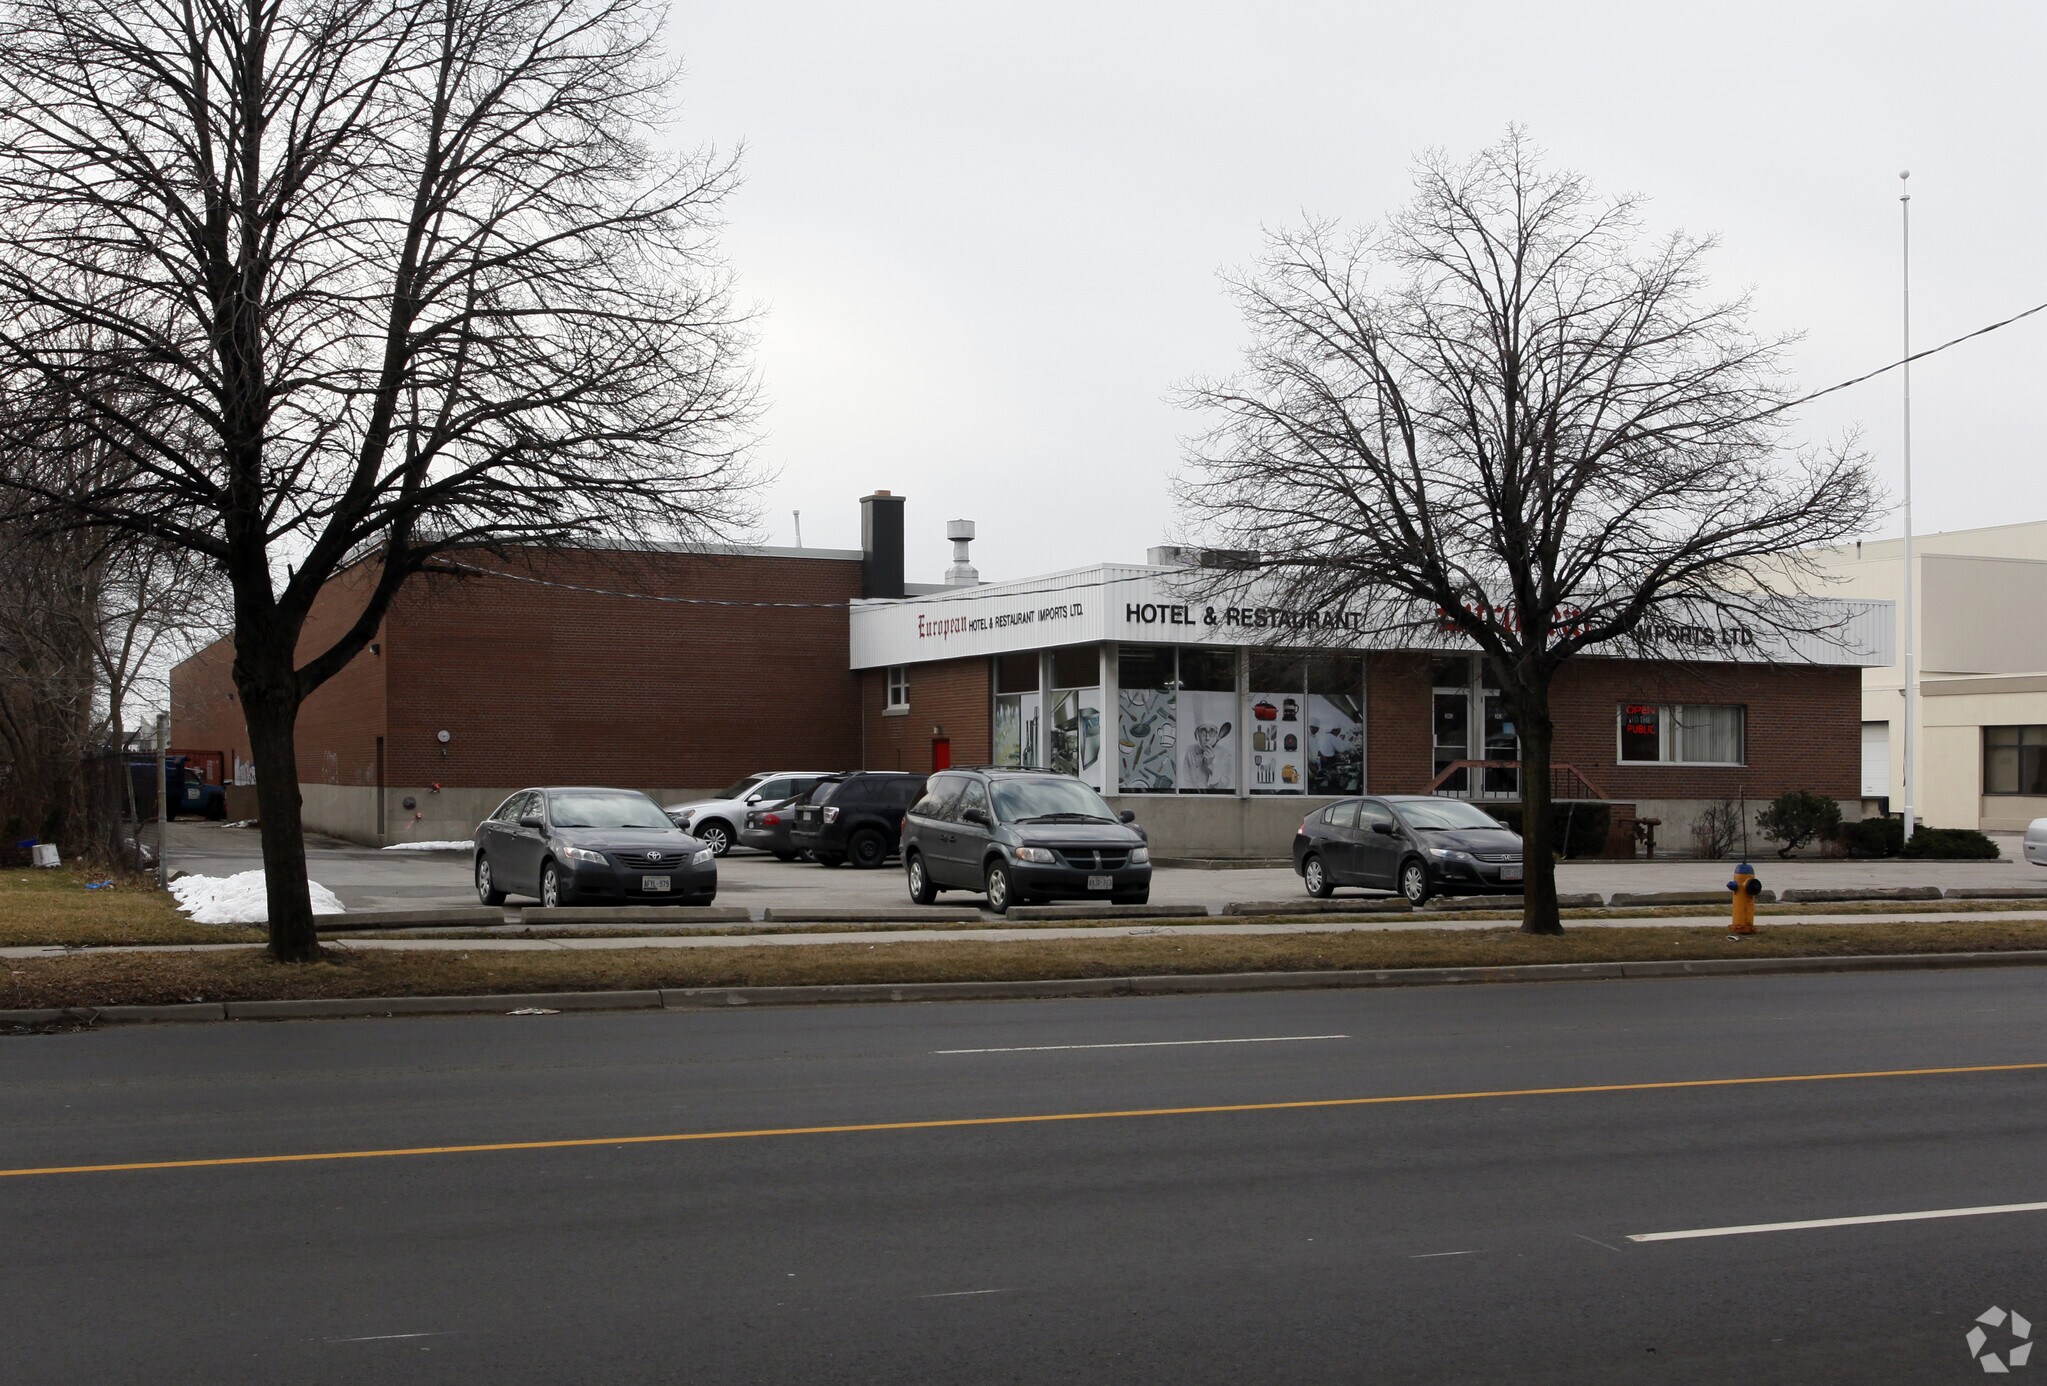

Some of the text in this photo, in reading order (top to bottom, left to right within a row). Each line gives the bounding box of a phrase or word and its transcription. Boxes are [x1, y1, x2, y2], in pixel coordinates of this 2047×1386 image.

[918, 614, 967, 640] European
[969, 617, 988, 632] HOTEL
[995, 610, 1035, 628] RESTAURANT
[1038, 605, 1068, 622] IMPORTS
[1126, 603, 1363, 630] HOTEL & RESTAURANT
[1632, 624, 1715, 646] MPORTS
[1626, 705, 1656, 714] OPEN
[1627, 724, 1655, 734] PUBLIC
